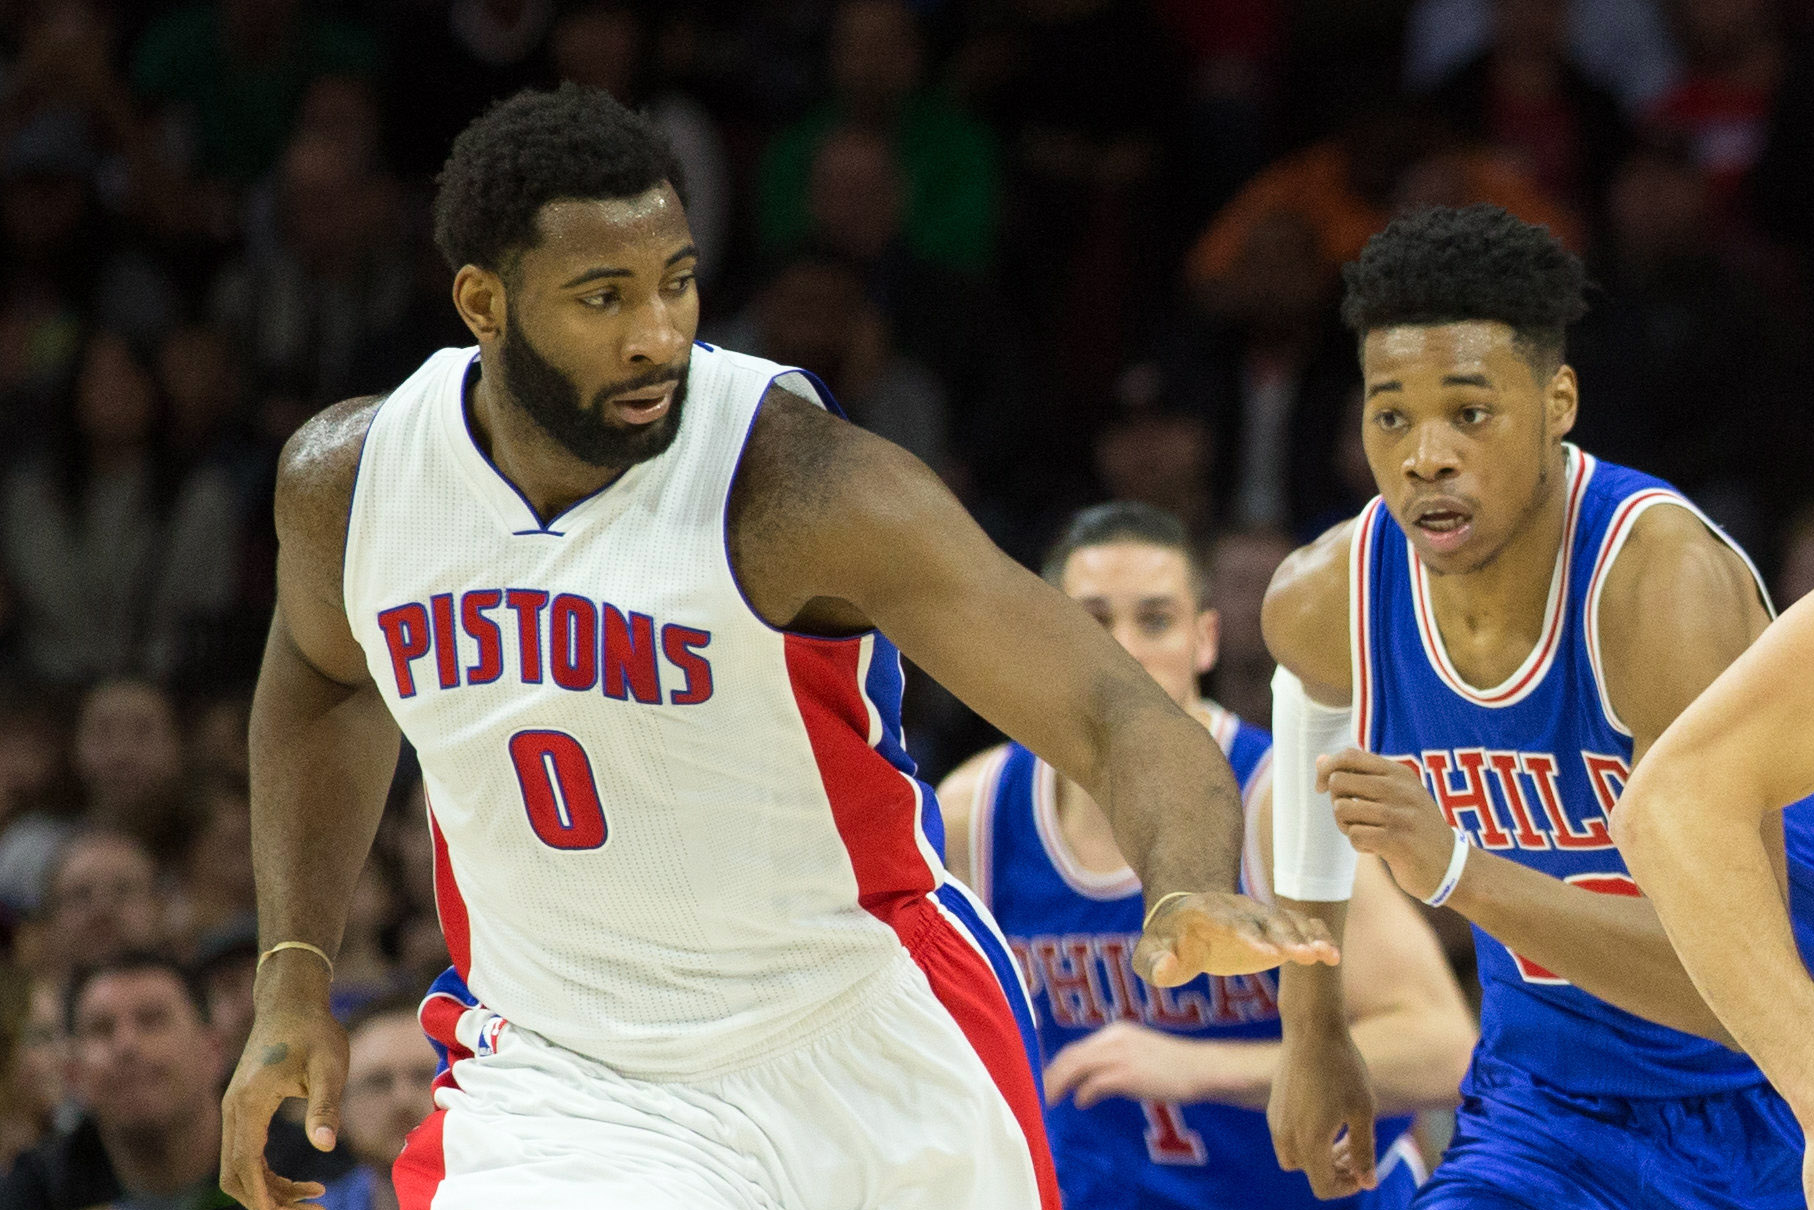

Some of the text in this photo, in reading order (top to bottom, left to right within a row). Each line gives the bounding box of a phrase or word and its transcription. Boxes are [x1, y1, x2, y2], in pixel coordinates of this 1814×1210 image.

[377, 587, 714, 705] PISTONS
[508, 729, 609, 851] 0
[1380, 747, 1634, 851] HIL
